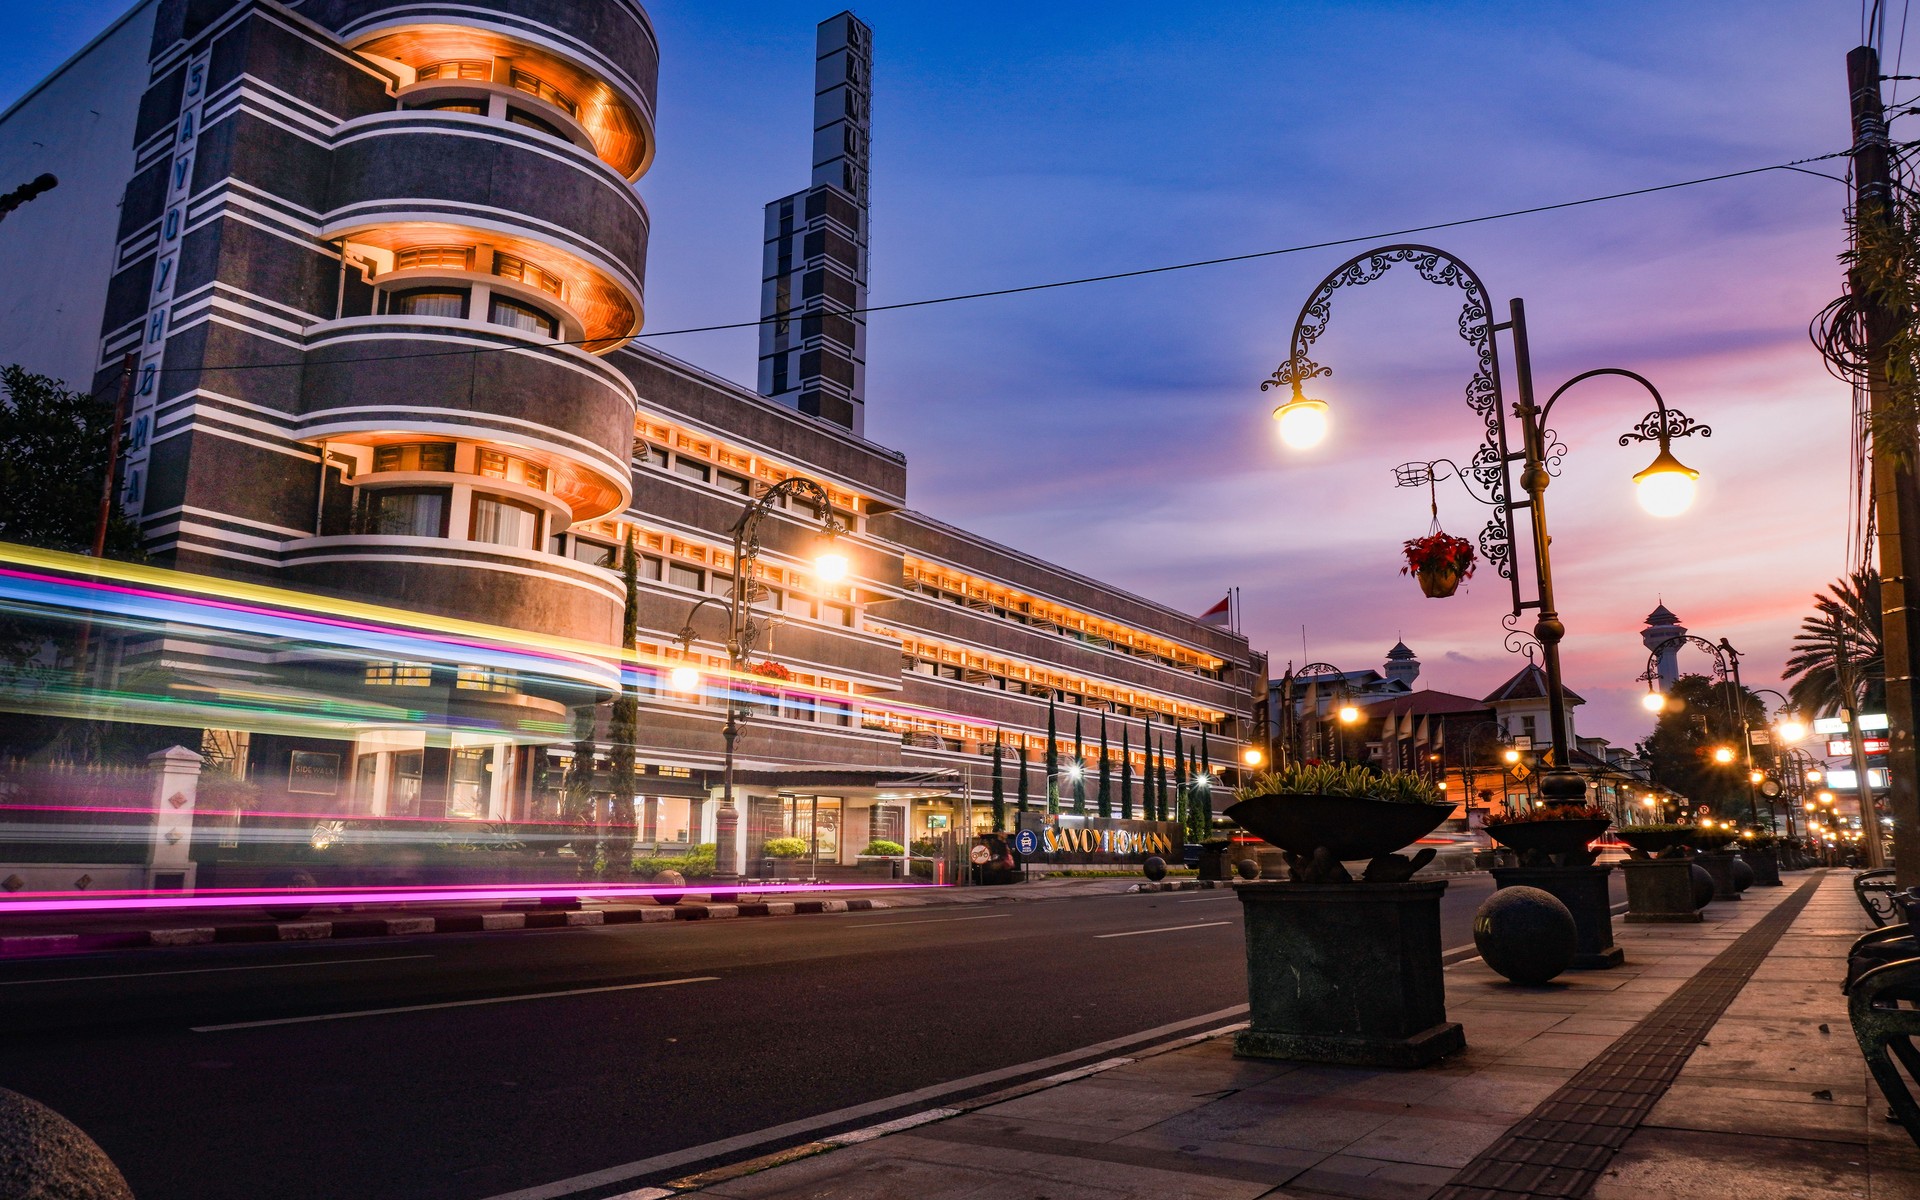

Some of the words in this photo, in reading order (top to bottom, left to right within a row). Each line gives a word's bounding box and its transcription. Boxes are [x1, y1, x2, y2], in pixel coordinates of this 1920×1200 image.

[849, 20, 861, 194] SAVOY
[1043, 825, 1104, 853] SAVOY
[1107, 829, 1173, 854] HOMANN
